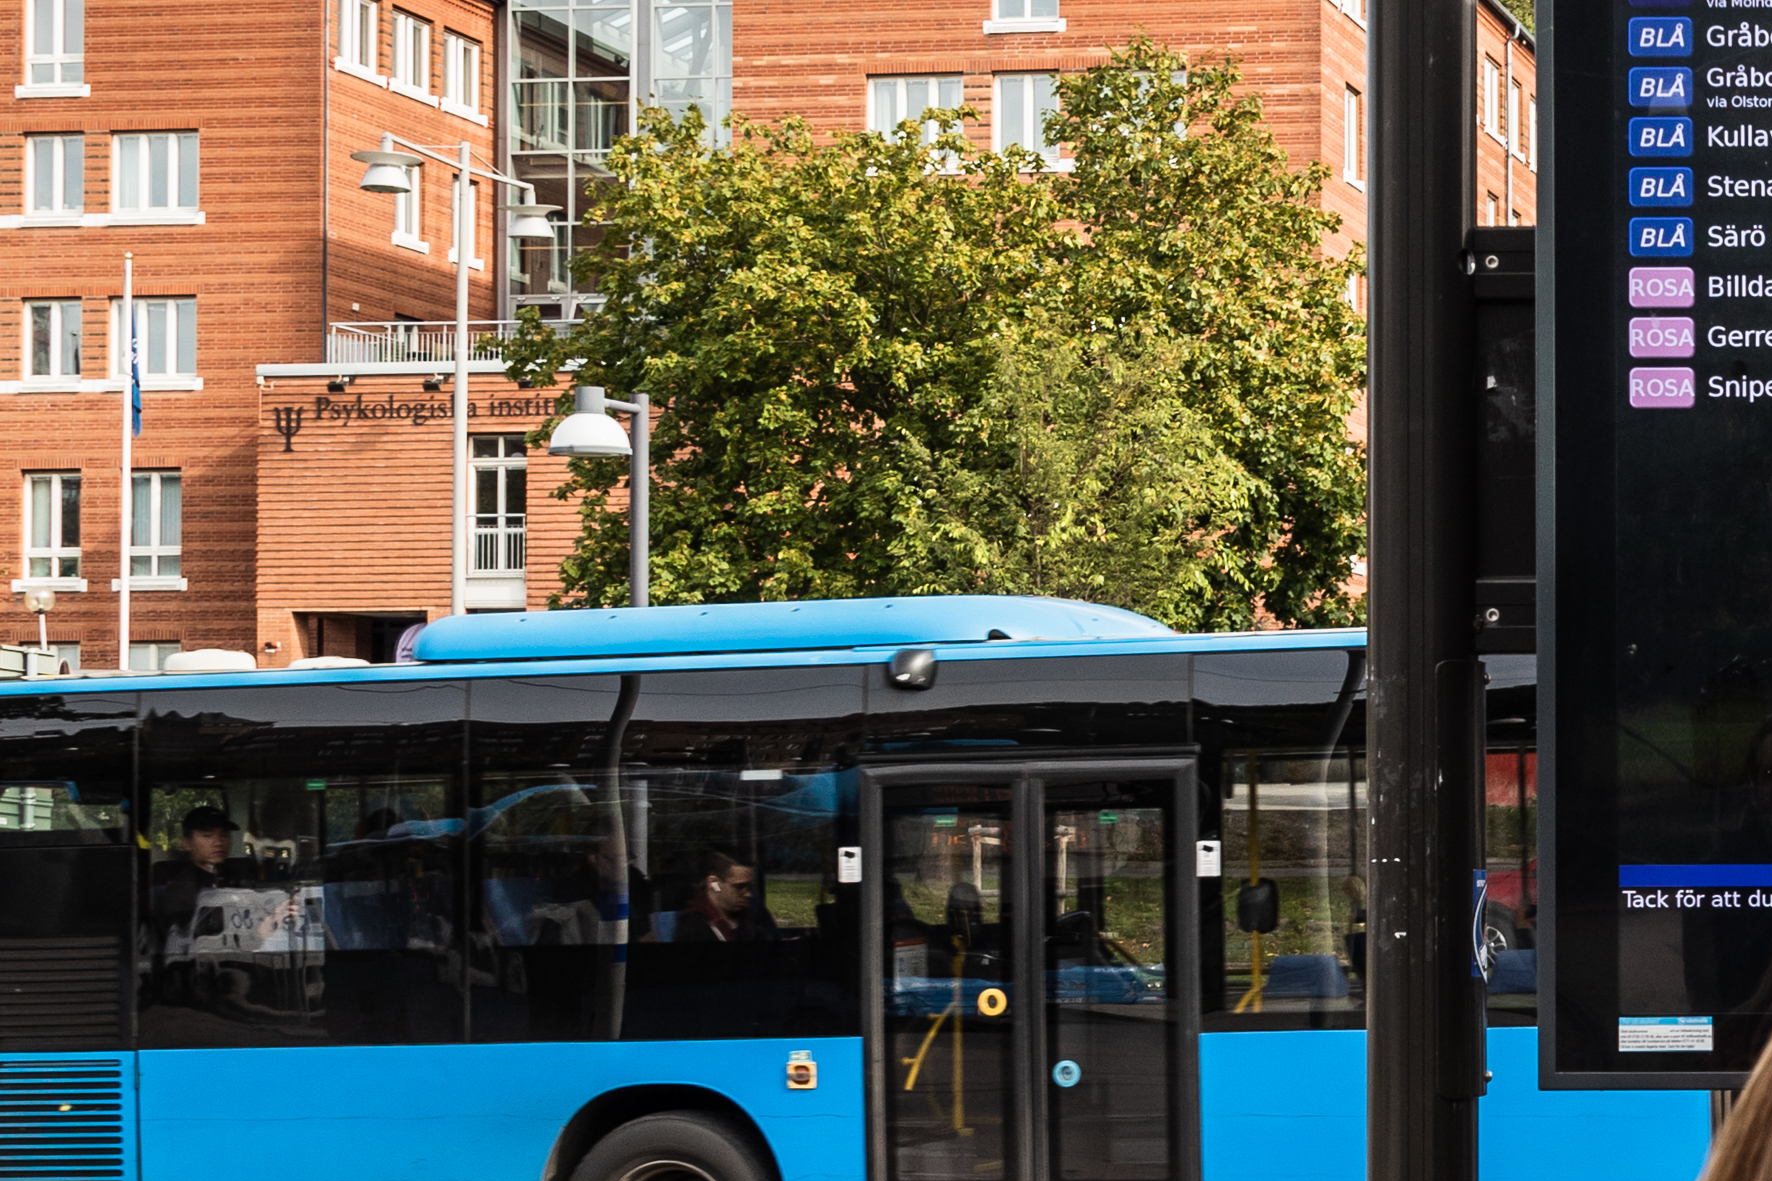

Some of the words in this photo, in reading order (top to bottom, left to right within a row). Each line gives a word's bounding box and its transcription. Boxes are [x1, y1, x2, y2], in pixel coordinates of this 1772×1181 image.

[1639, 22, 1685, 48] BLÅ
[1639, 72, 1685, 98] BLÅ
[1706, 95, 1728, 108] via
[1639, 122, 1685, 148] BLÅ
[1640, 172, 1686, 198] BLÅ
[1640, 223, 1686, 248] BLÅ
[1707, 223, 1766, 248] Särö
[1631, 278, 1695, 297] ROSA
[1631, 328, 1695, 347] ROSA
[1631, 378, 1695, 397] ROSA
[1621, 889, 1670, 909] Tack
[1674, 889, 1706, 908] för
[1711, 890, 1741, 908] att
